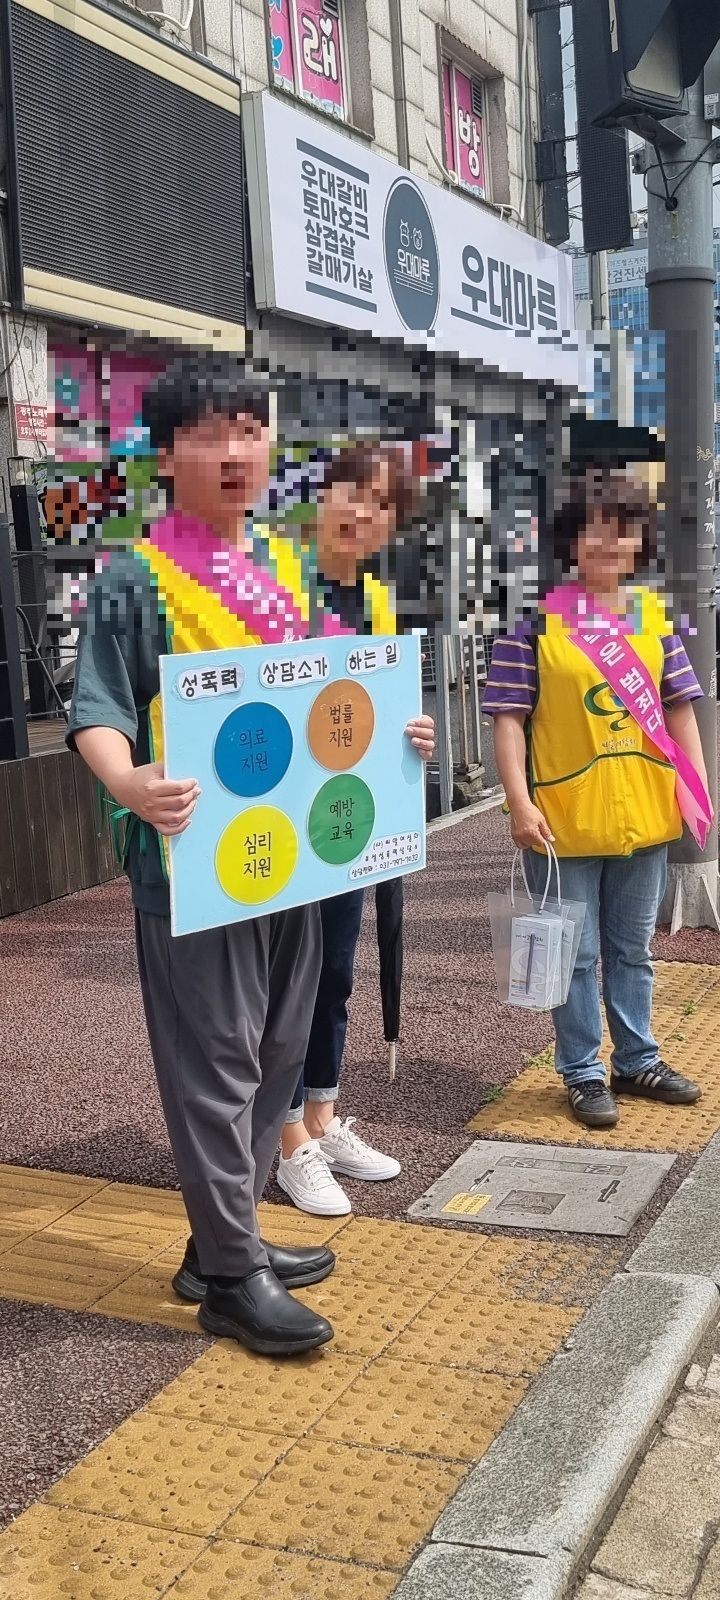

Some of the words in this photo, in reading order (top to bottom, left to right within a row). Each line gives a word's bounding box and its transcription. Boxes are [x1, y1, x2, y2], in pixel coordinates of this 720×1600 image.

[302, 12, 339, 84] 래
[457, 108, 484, 179] 방
[300, 159, 368, 214] 우대갈비
[303, 189, 370, 240] 토마호크
[304, 219, 356, 262] 삼겹살
[306, 247, 374, 294] 갈매기살
[397, 248, 431, 283] 우대마루
[461, 244, 558, 331] 우대마루
[180, 667, 239, 698] 성폭력
[262, 658, 329, 685] 상담소가
[348, 649, 377, 671] 하는
[384, 642, 399, 664] 일
[329, 703, 355, 725] 법률
[618, 667, 663, 734] 범죄다
[238, 728, 268, 750] 의료
[328, 728, 354, 748] 지원
[241, 751, 269, 774] 지원
[329, 797, 355, 818] 예방
[243, 831, 272, 856] 심리
[329, 821, 355, 842] 교육
[242, 857, 272, 880] 지원
